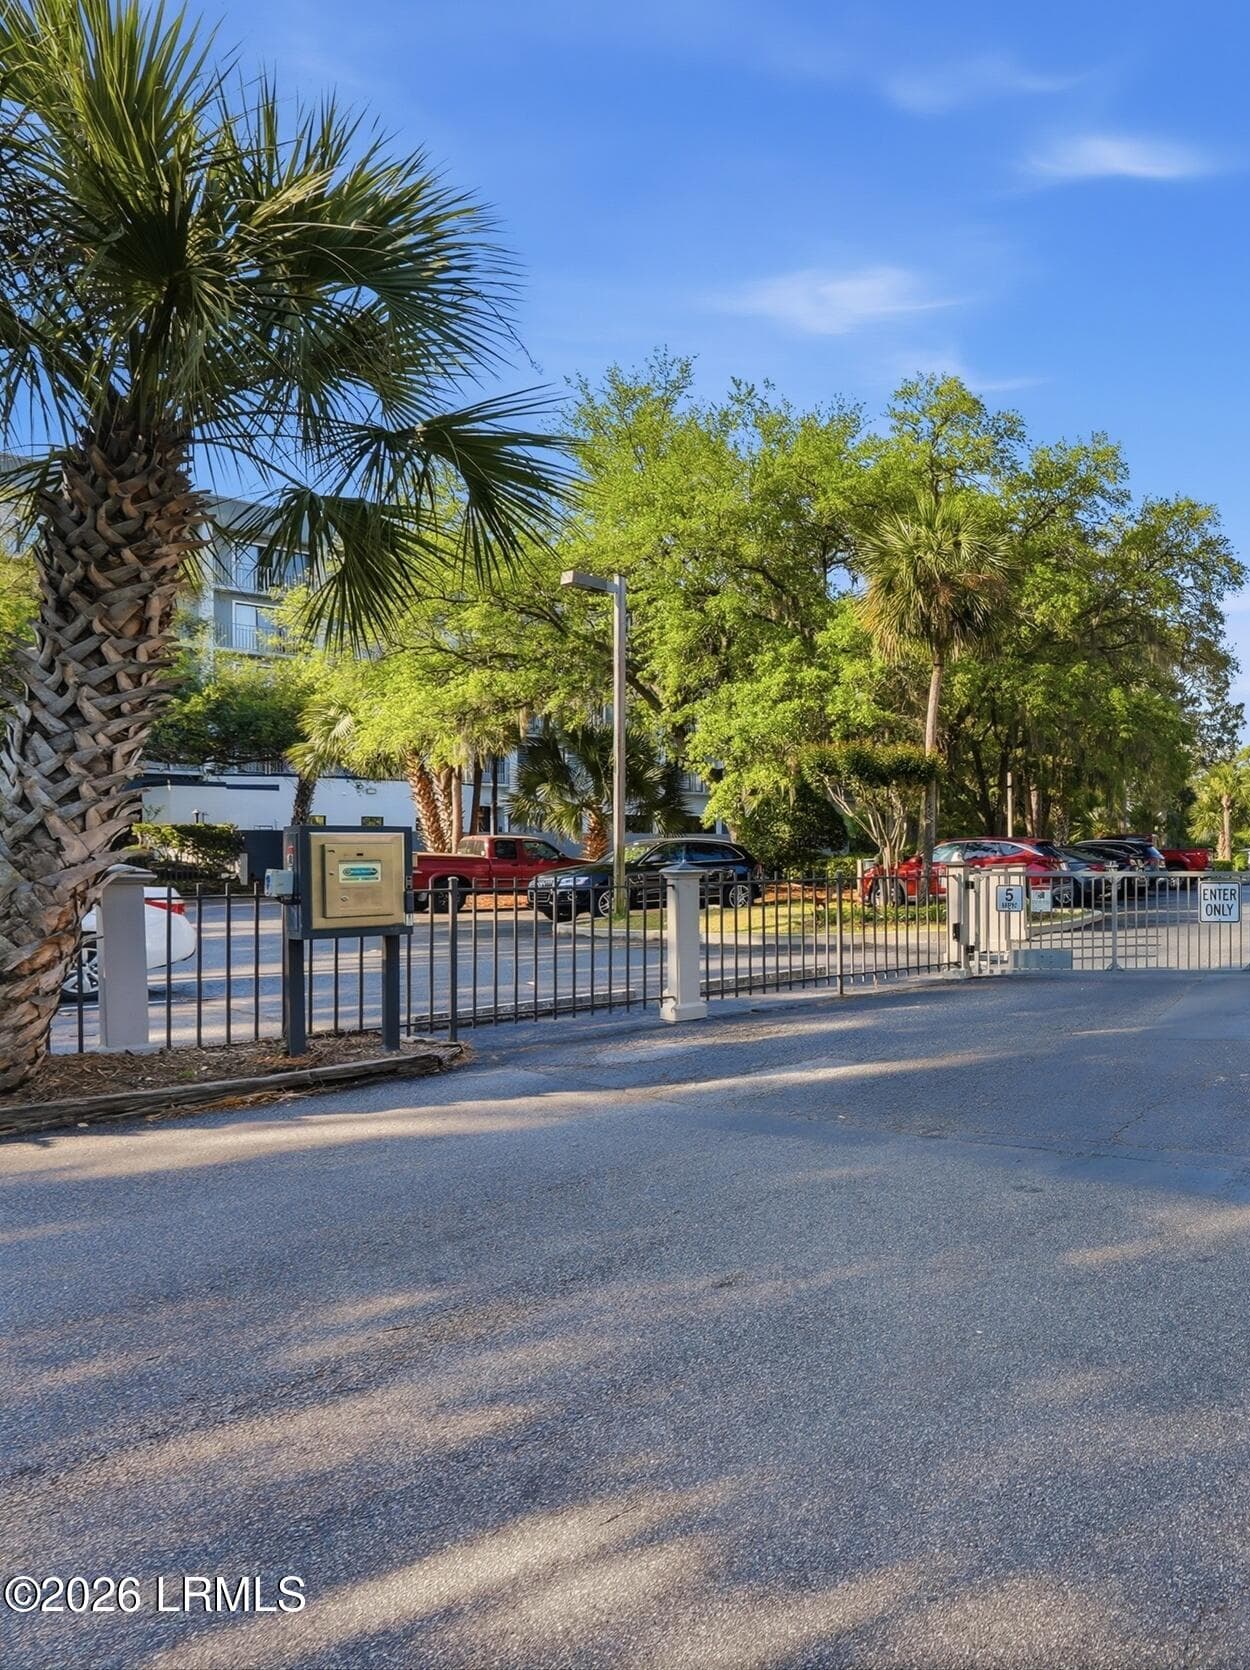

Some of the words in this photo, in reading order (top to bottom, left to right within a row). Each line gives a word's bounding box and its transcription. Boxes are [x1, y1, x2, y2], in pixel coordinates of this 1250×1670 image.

[1005, 888, 1014, 902] 5
[1203, 889, 1237, 901] ENTER
[1205, 904, 1234, 916] ONLY
